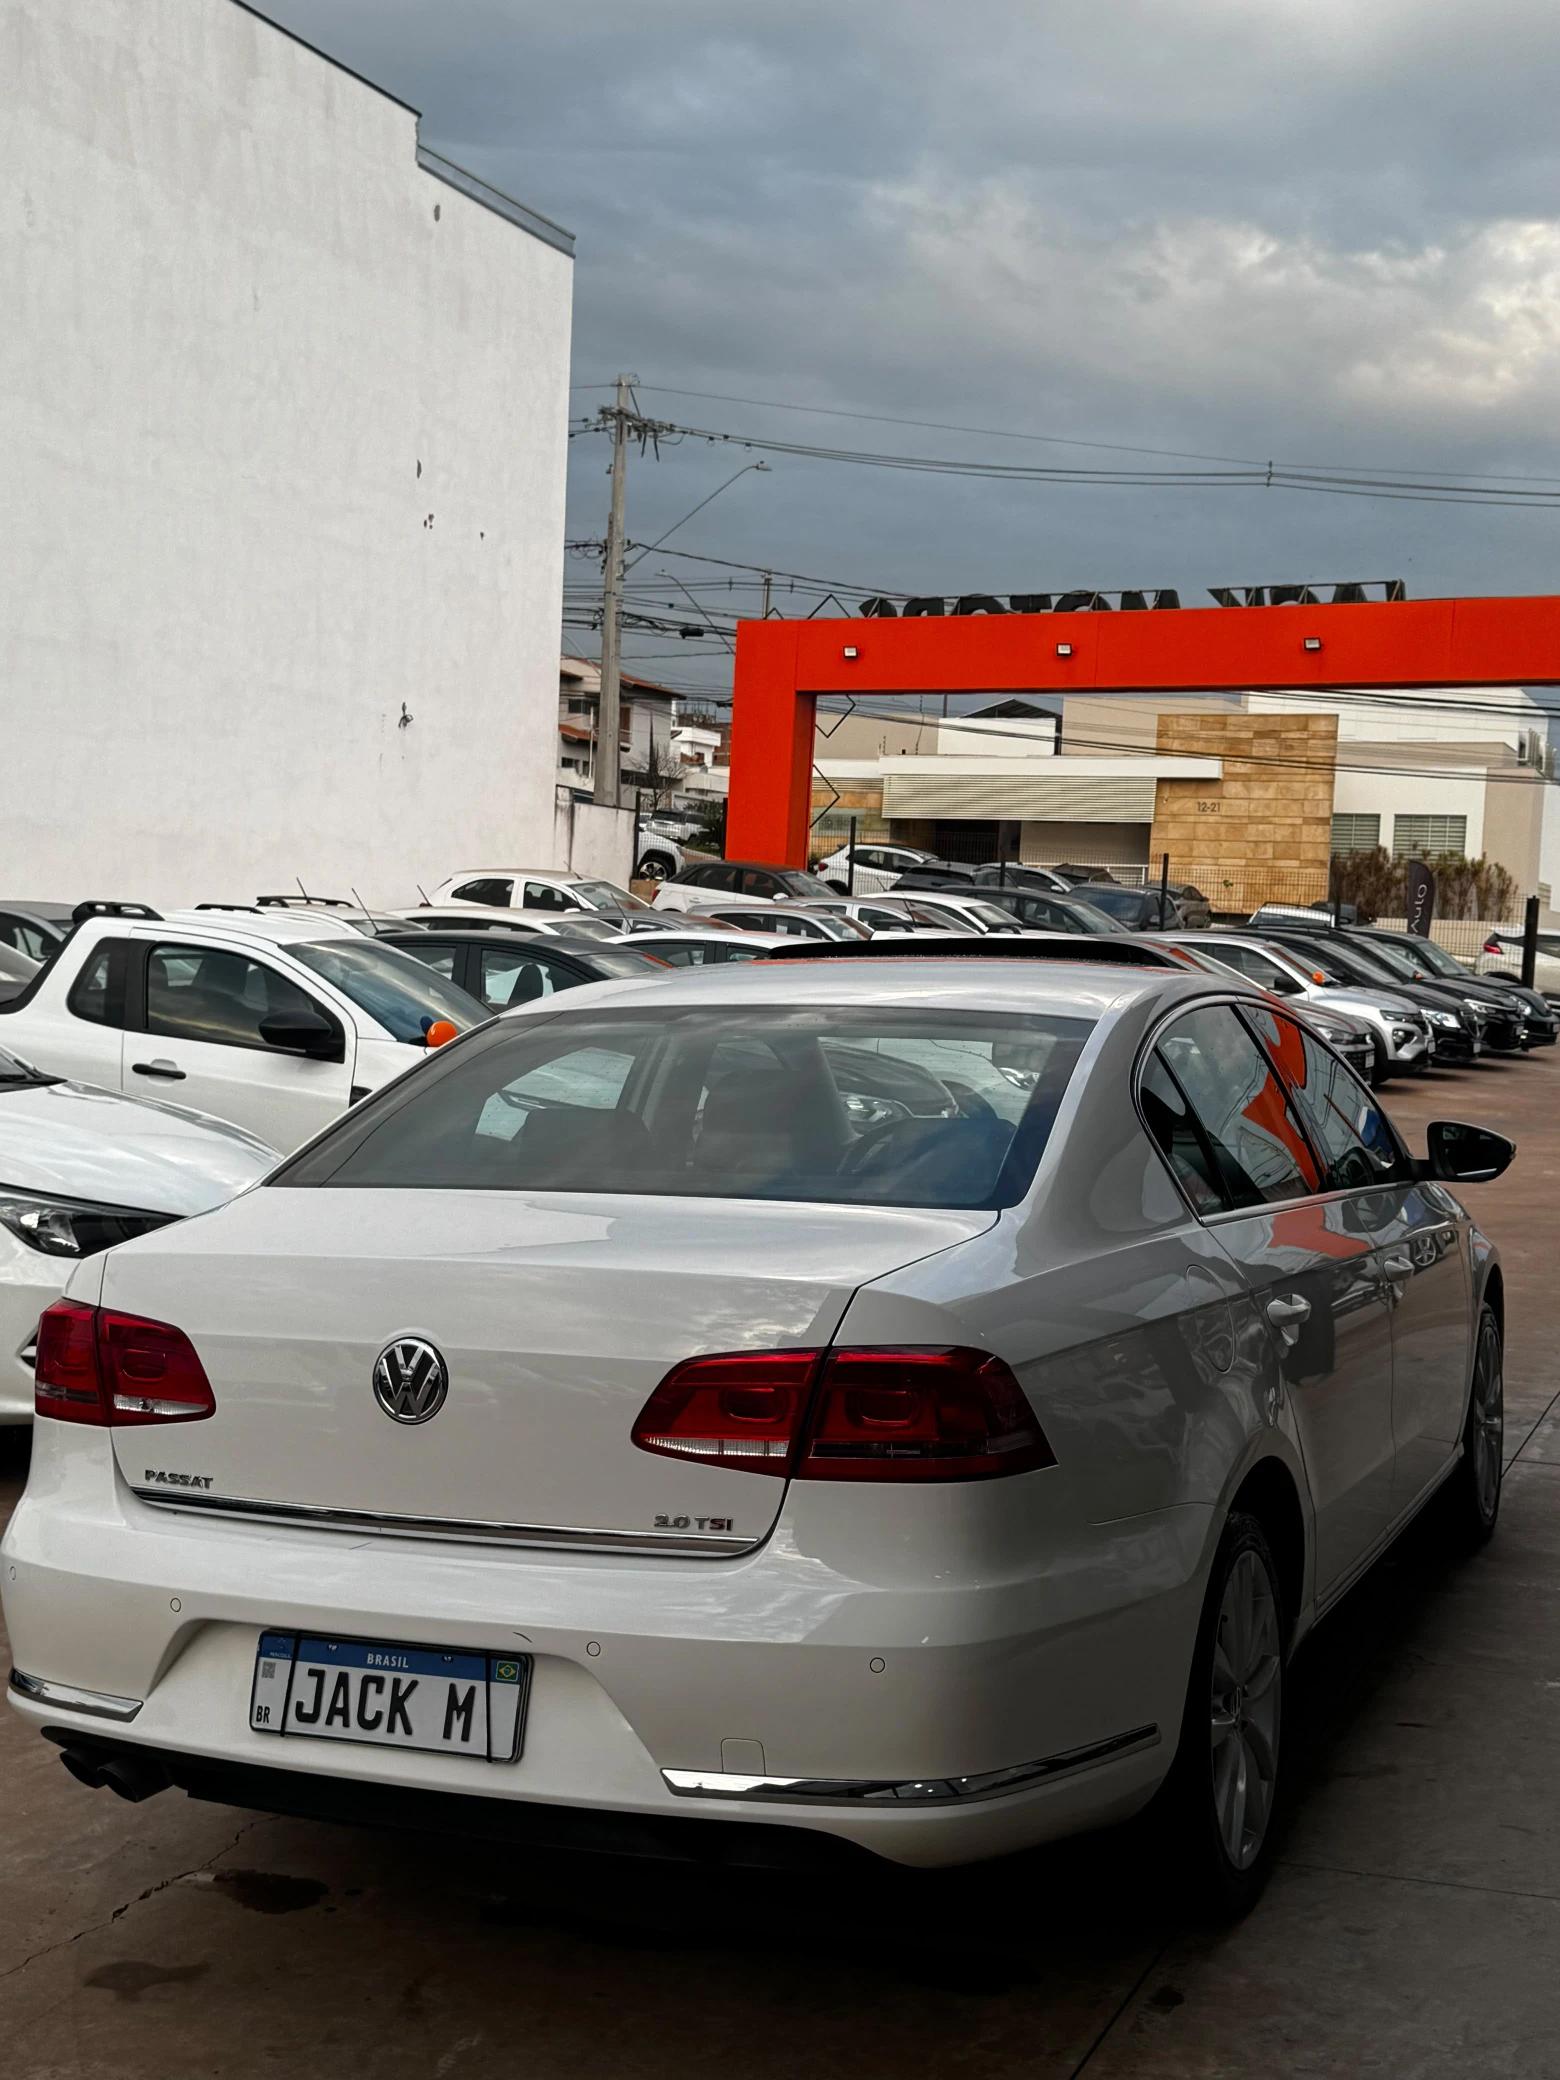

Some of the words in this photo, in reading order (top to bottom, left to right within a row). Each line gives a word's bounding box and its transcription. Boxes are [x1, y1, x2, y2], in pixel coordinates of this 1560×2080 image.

[1197, 801, 1221, 813] 12-21
[144, 1469, 214, 1489] PASSAT
[654, 1513, 691, 1529] 2.0
[695, 1516, 734, 1531] TSI
[366, 1653, 409, 1668] BRASIL
[295, 1668, 419, 1735] JACK
[442, 1683, 476, 1742] M
[255, 1705, 270, 1724] BR
